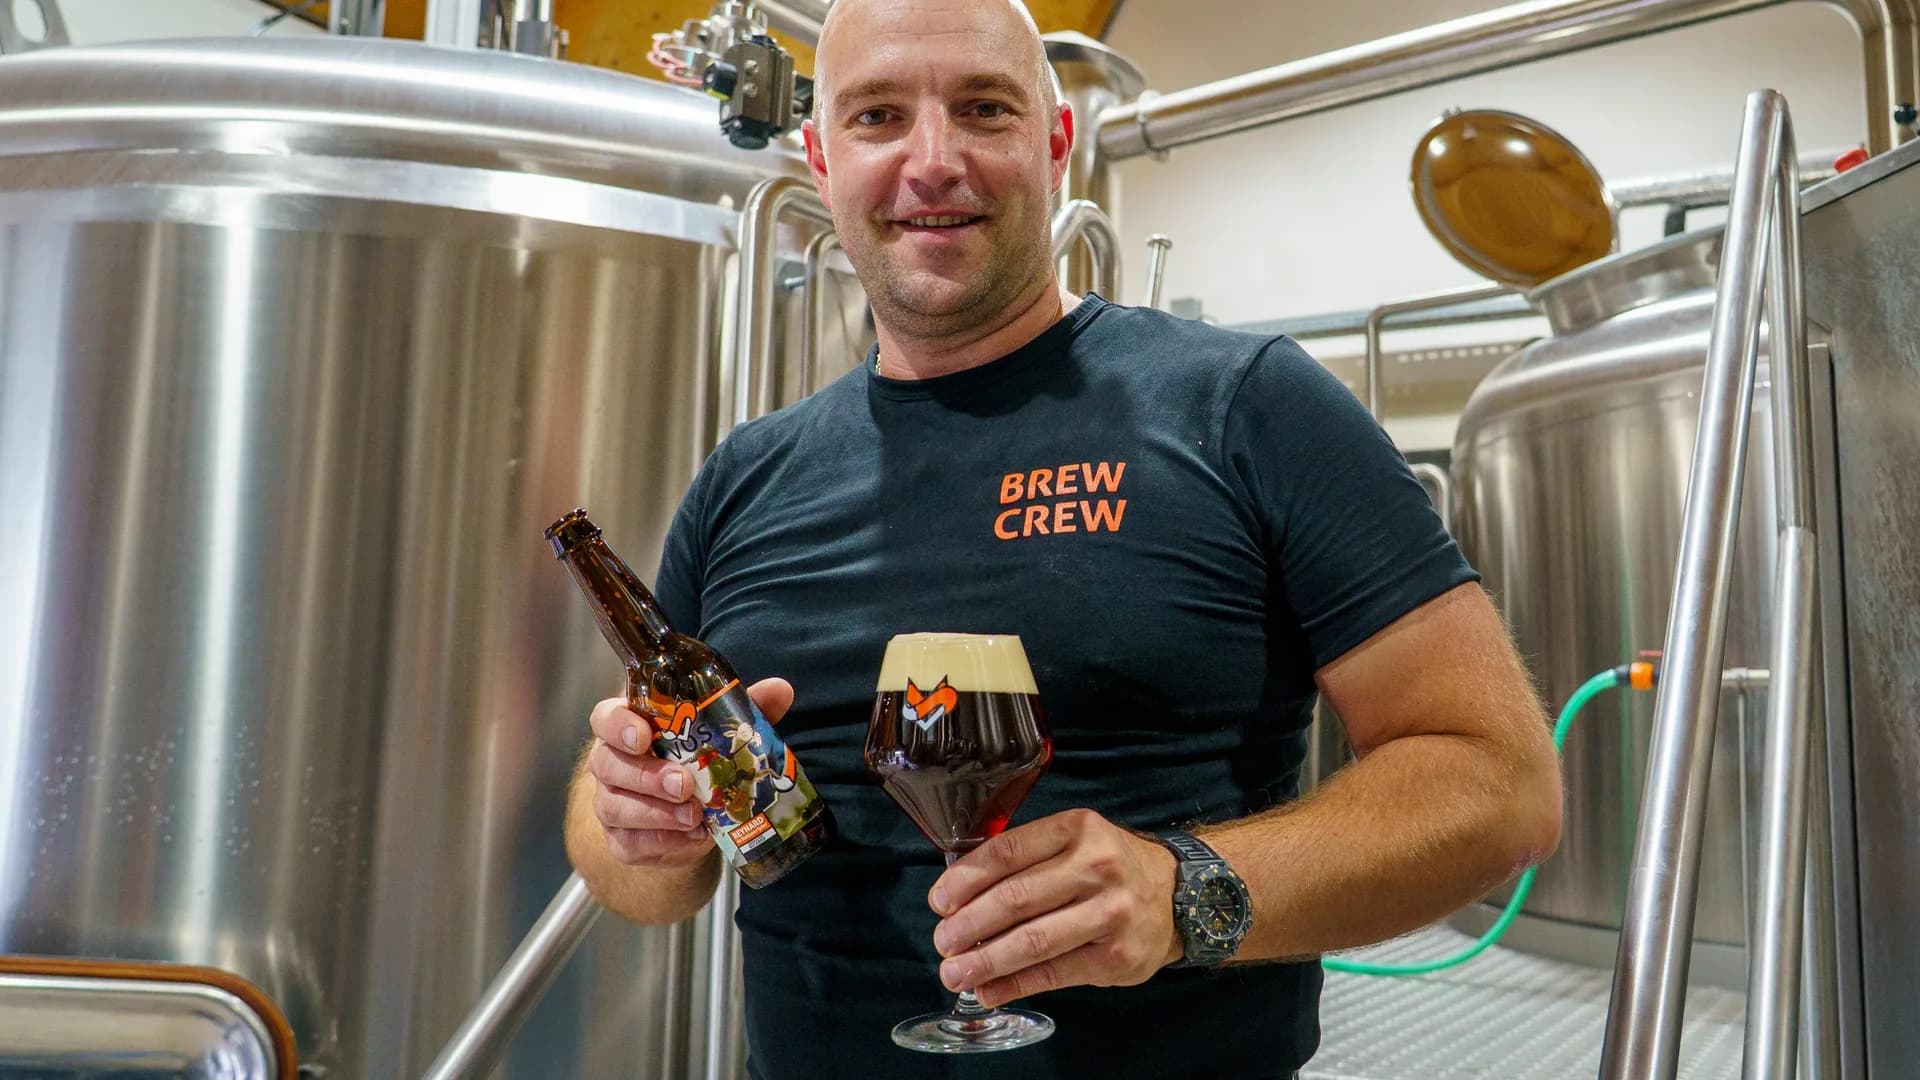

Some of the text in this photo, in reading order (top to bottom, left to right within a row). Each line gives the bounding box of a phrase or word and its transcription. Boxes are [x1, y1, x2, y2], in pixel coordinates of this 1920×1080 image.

[1000, 461, 1126, 504] BREW
[993, 499, 1127, 540] CREW
[665, 723, 713, 760] VOS
